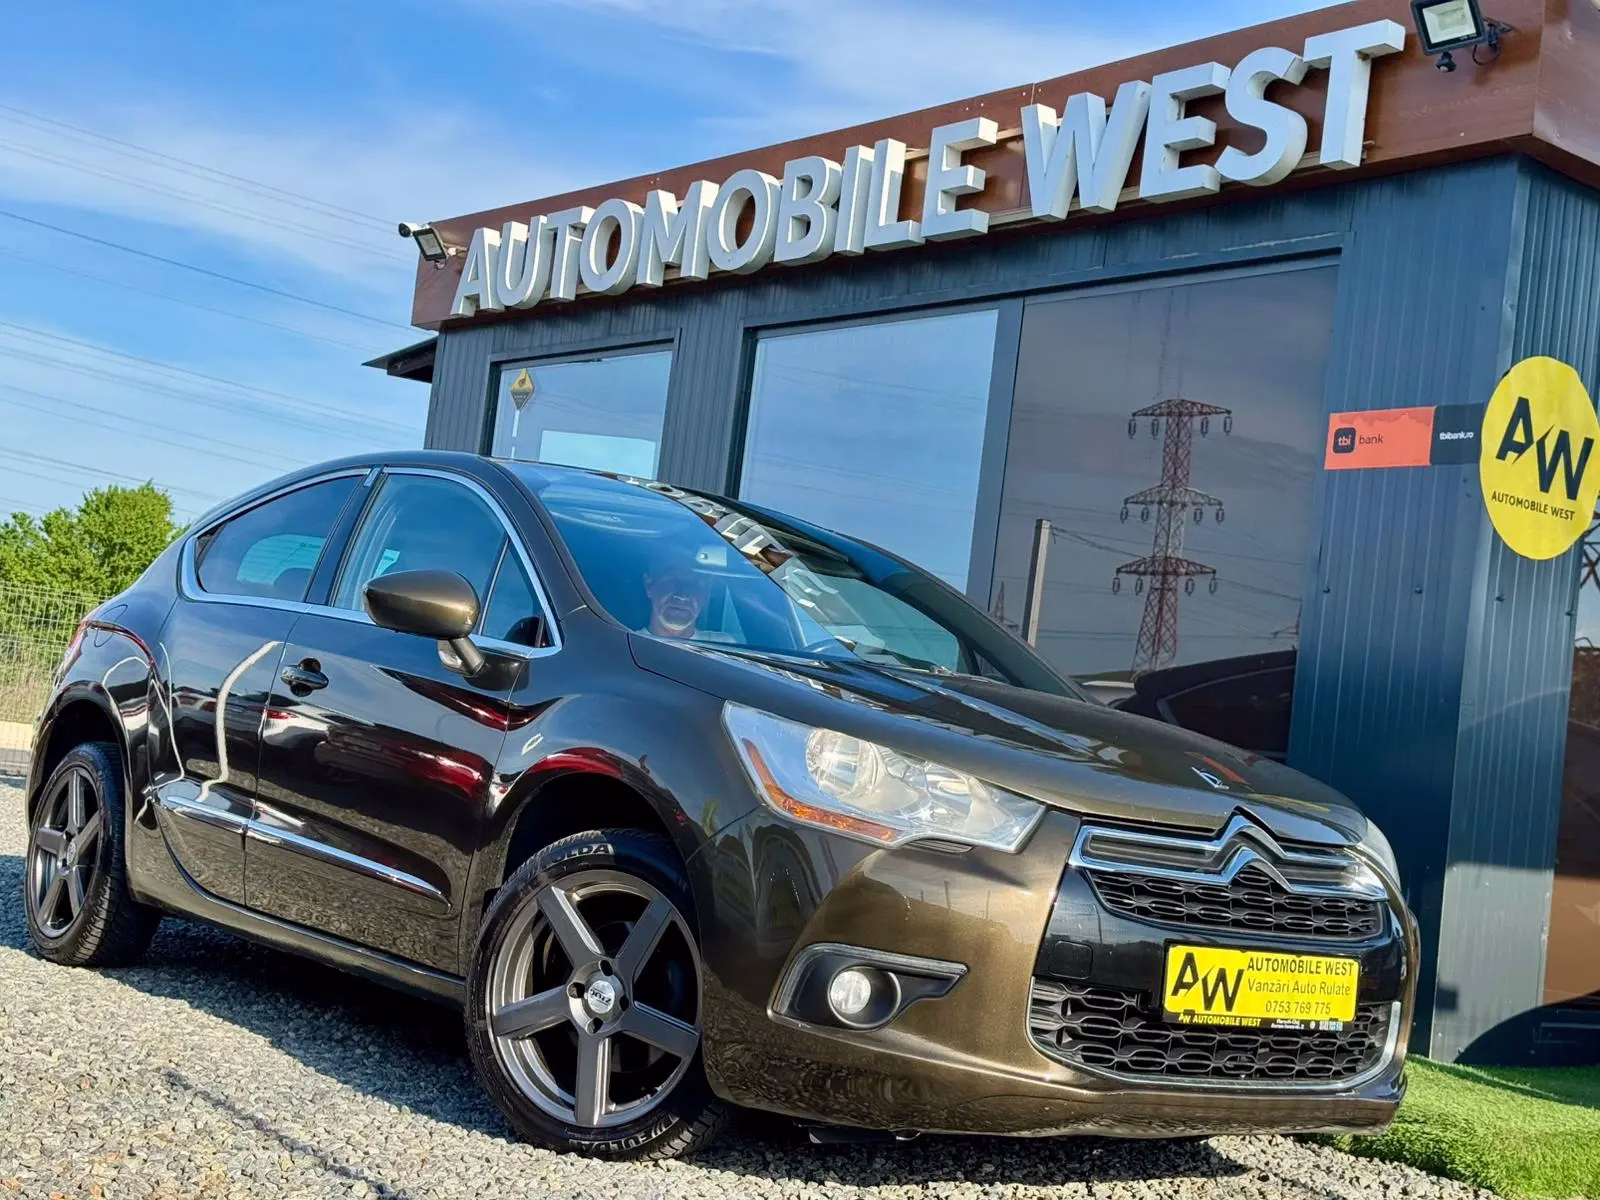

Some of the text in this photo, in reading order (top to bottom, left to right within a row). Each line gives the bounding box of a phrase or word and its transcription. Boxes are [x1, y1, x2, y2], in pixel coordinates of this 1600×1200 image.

[449, 19, 1406, 317] AUTOMOBILE WEST
[1359, 433, 1384, 445] bank
[1491, 490, 1575, 520] AUTOMOBILE WEST
[1247, 957, 1354, 976] AUTOMOBILE WEST
[1292, 980, 1317, 994] Auto
[1320, 981, 1351, 996] Rulate
[1265, 1000, 1331, 1015] 0753 769 775
[1192, 1014, 1240, 1026] AUTOMOBILE
[1241, 1017, 1261, 1027] WEST
